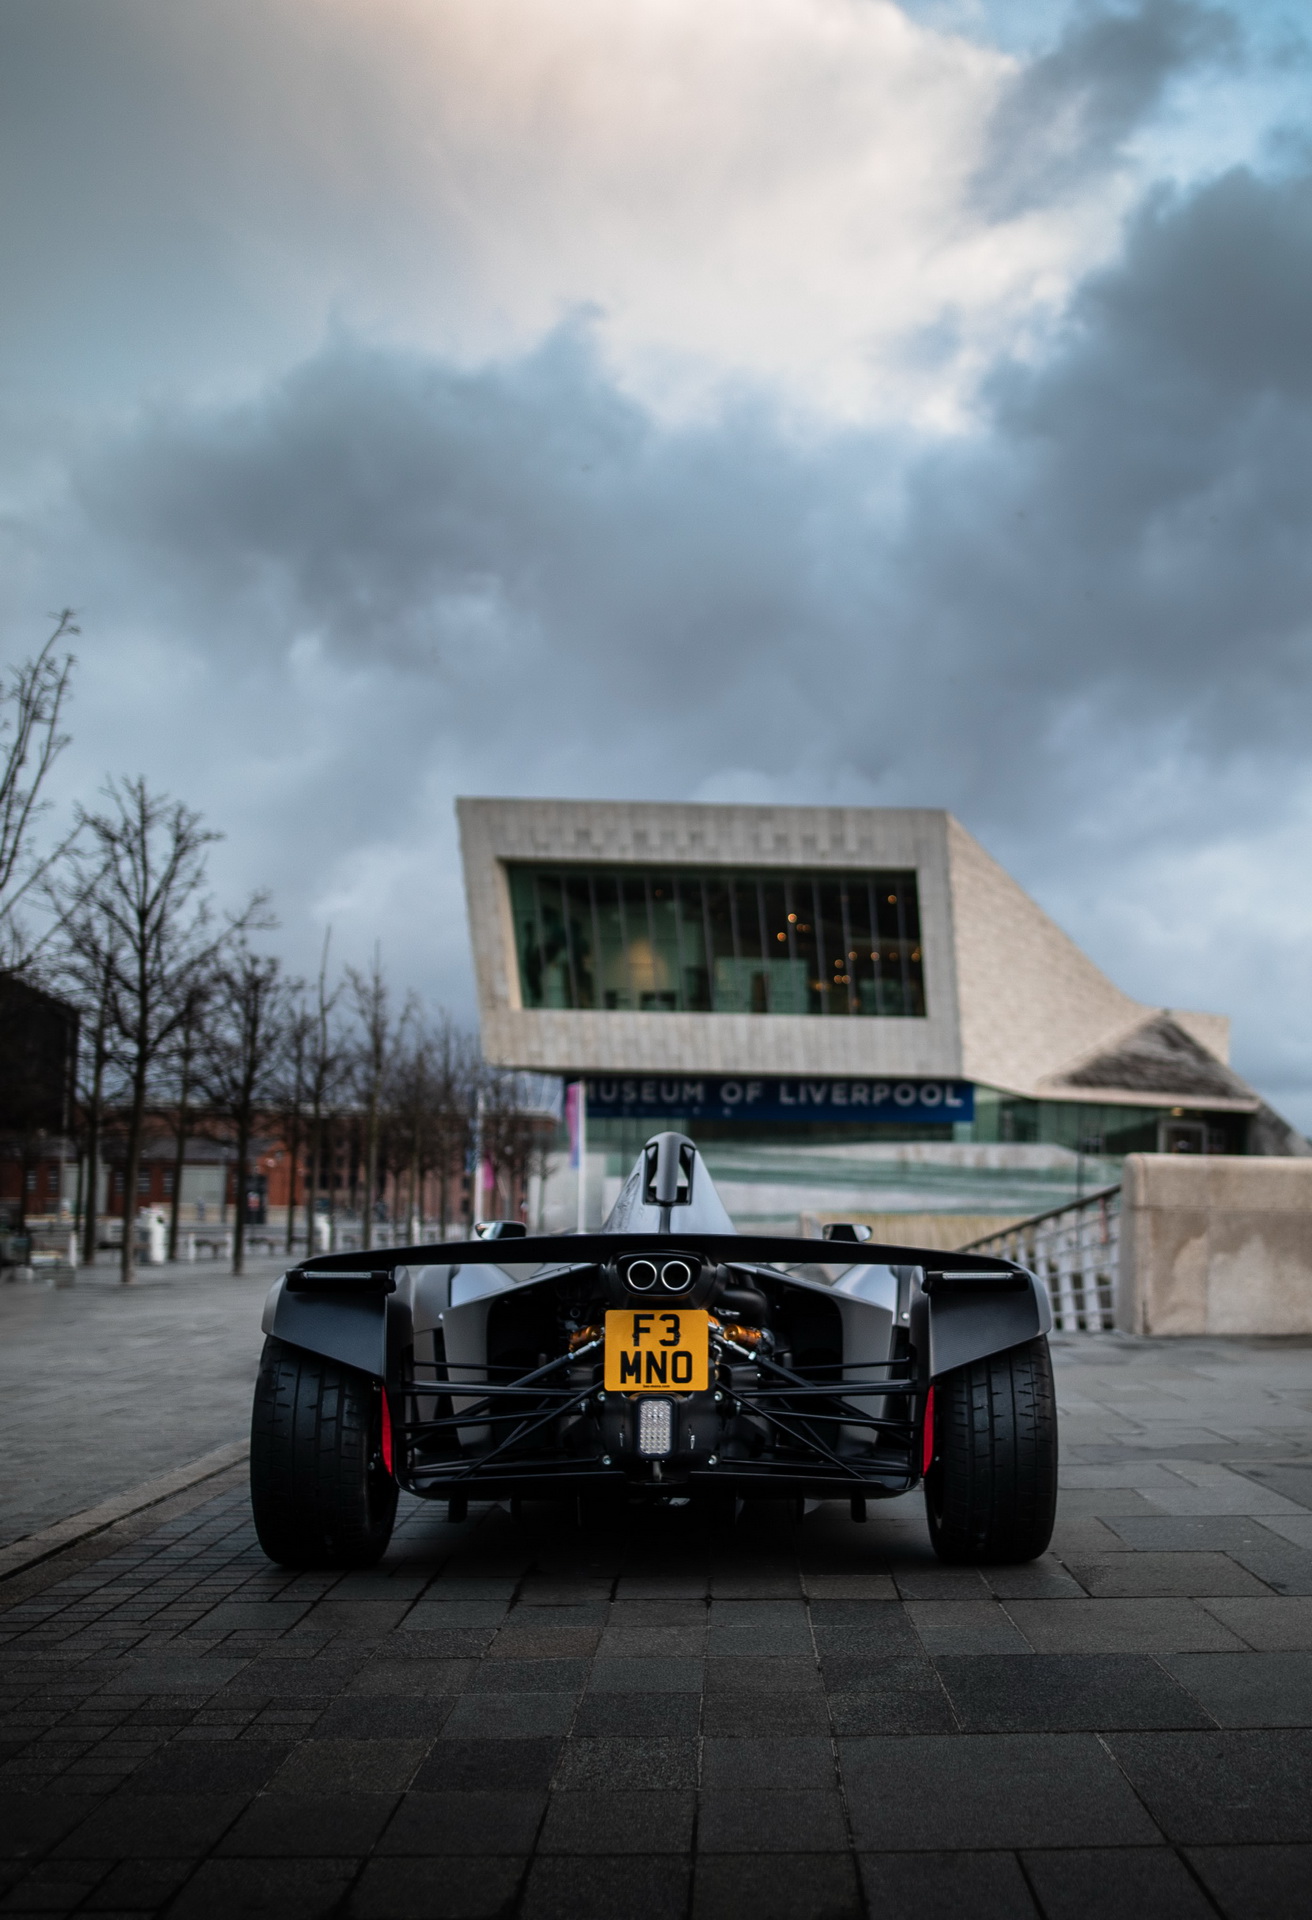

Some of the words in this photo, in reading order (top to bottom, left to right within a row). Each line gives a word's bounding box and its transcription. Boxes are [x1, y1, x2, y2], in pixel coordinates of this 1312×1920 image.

[720, 1081, 762, 1105] OF
[779, 1082, 963, 1108] LIVERPOOL
[633, 1313, 680, 1347] F3
[620, 1350, 693, 1384] MNO
